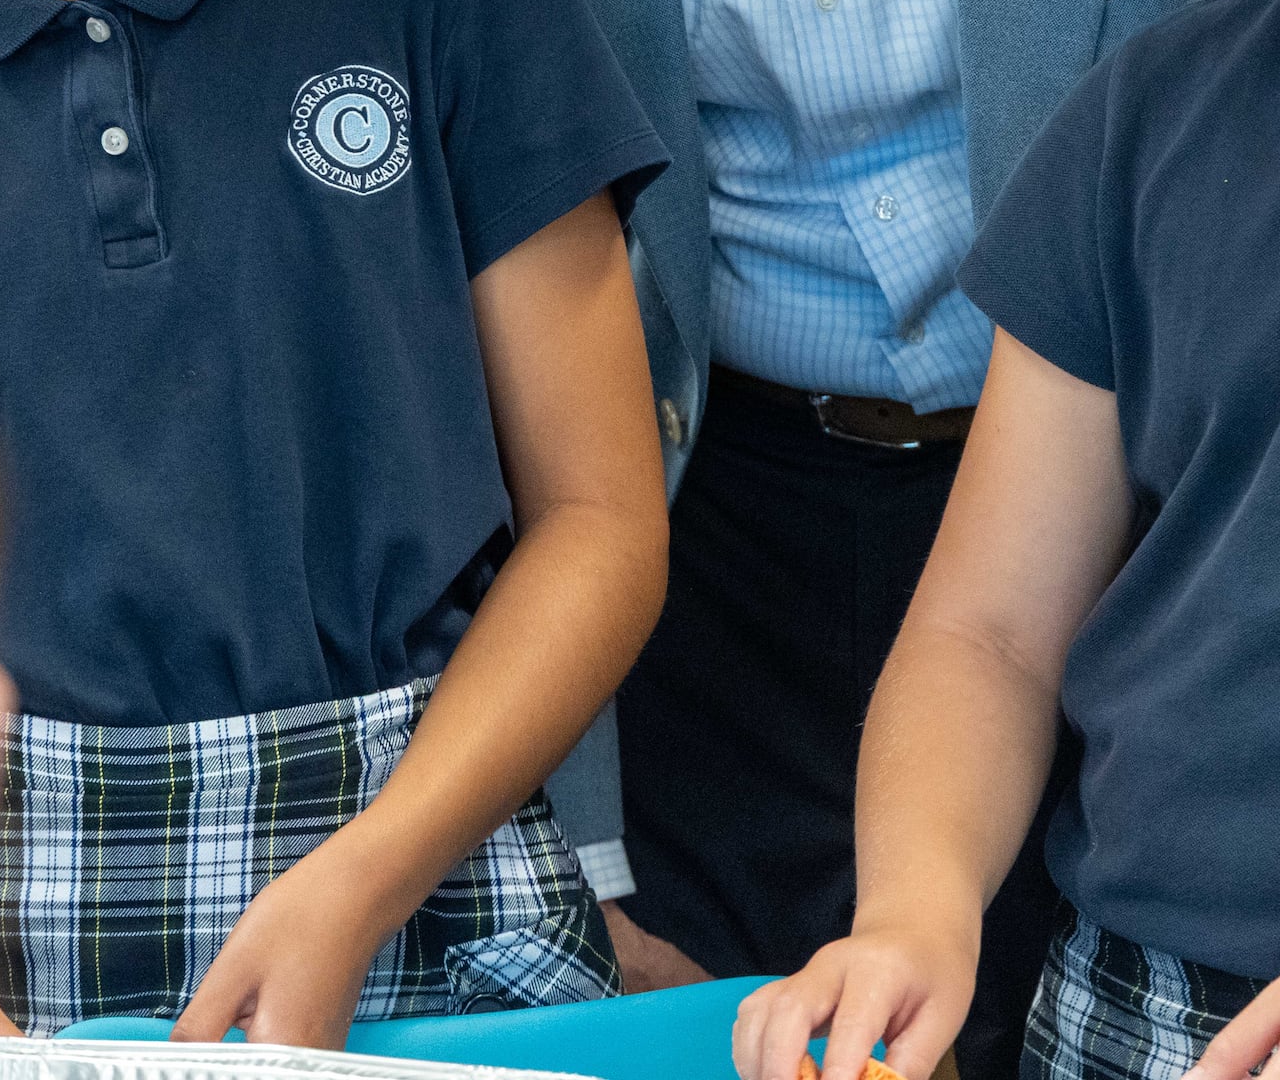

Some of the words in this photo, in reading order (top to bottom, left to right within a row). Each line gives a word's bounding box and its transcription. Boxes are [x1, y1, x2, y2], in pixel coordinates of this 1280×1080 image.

[293, 73, 407, 130] CORNERSTONE
[332, 104, 371, 156] C
[297, 137, 362, 189] CHRISTIAN
[364, 133, 410, 189] ACADEMY
